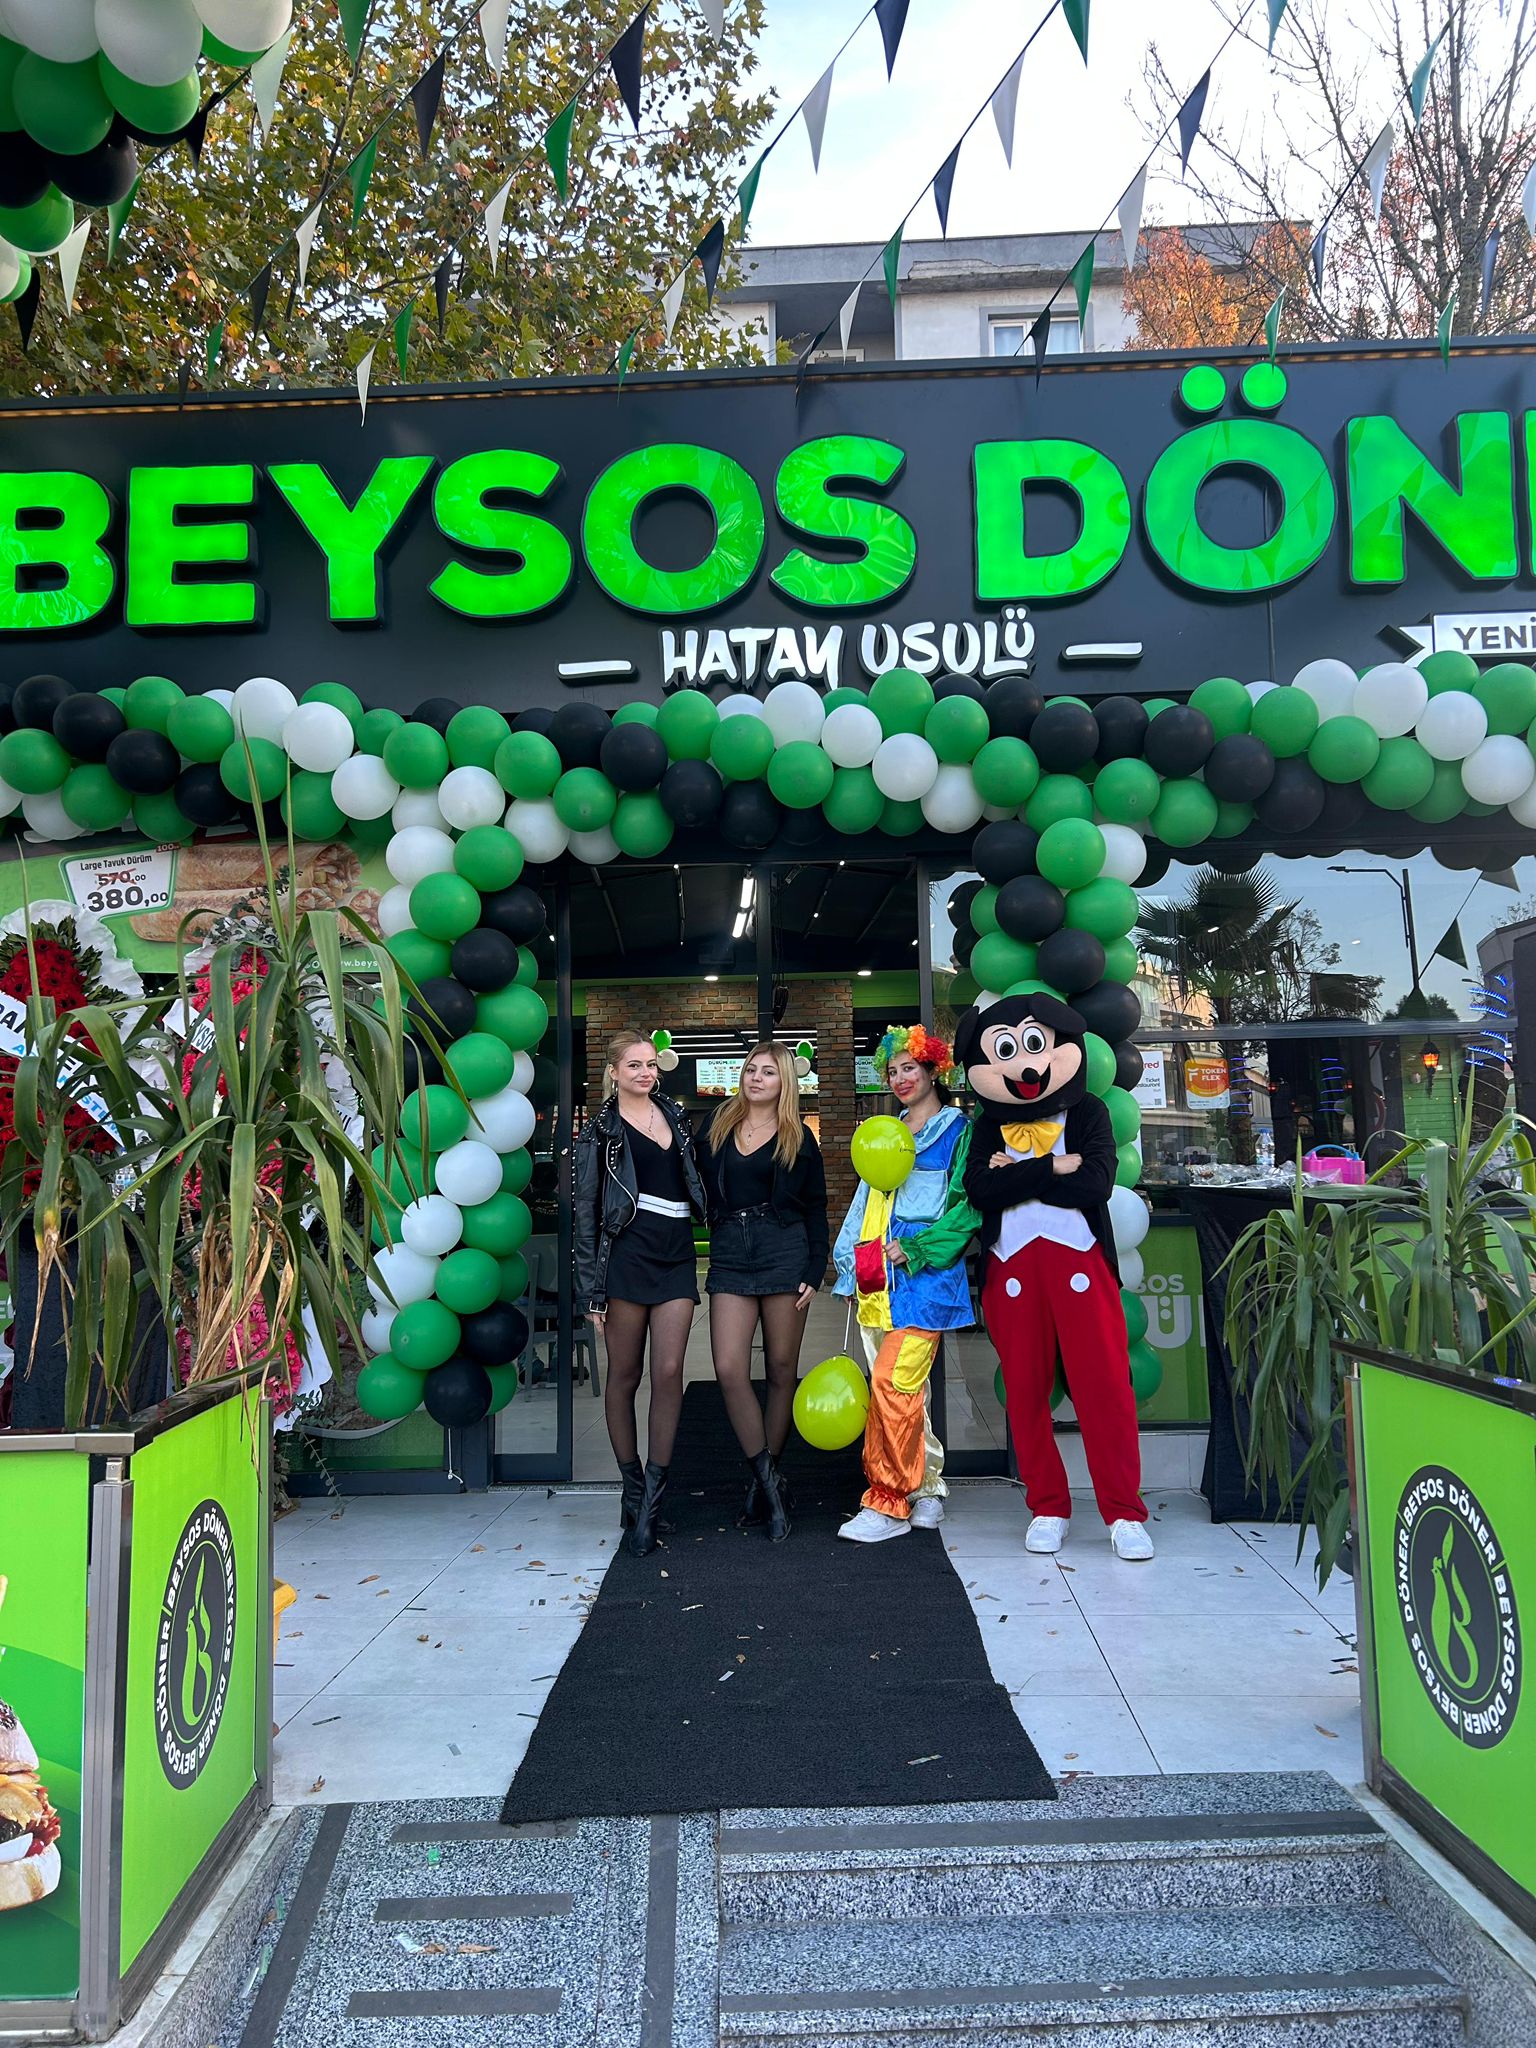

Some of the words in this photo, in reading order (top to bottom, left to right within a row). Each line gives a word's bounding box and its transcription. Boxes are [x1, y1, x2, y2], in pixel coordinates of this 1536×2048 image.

[0, 434, 917, 630] BEYSOS
[972, 364, 1536, 600] DÖN
[661, 624, 845, 689] HATAY
[861, 607, 1035, 677] USULÜ
[80, 861, 102, 871] Large
[103, 857, 126, 869] Tavuk
[127, 854, 152, 865] Dürüm
[167, 1517, 201, 1609] BEYSOS
[203, 1508, 228, 1557] DÖNER
[1403, 1478, 1445, 1528] BEYSOS
[1449, 1484, 1496, 1566] DÖNER
[224, 1556, 234, 1663] BEYSOS
[1398, 1528, 1414, 1623] DÖNER
[156, 1620, 170, 1733] DÖNER
[1411, 1632, 1459, 1725] BEYSOS
[1494, 1574, 1516, 1696] BEYSOS
[164, 1732, 196, 1775] BEYSOS
[199, 1678, 226, 1759] DÖNER
[1463, 1692, 1507, 1735] DÖNER
